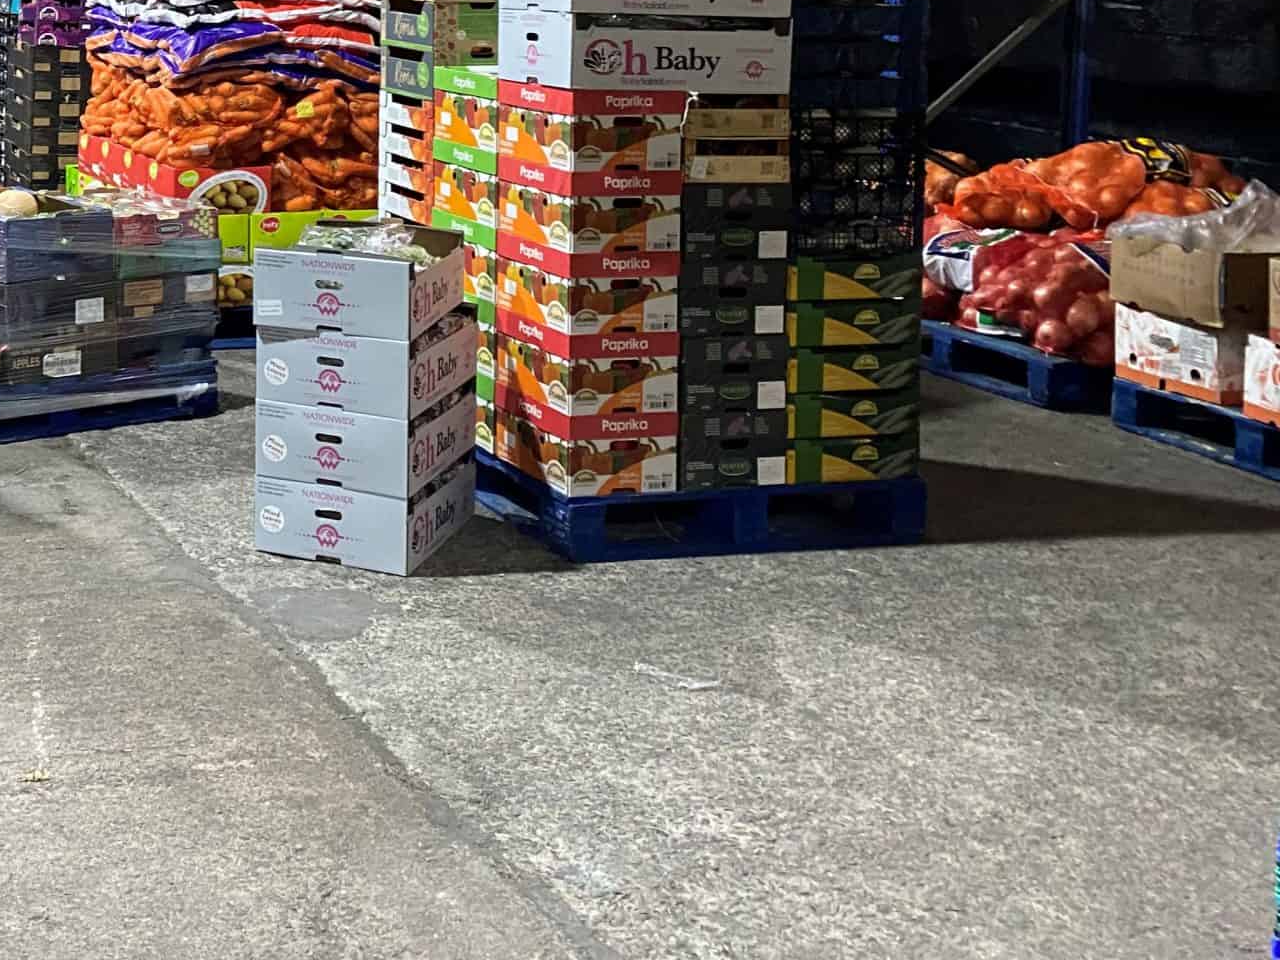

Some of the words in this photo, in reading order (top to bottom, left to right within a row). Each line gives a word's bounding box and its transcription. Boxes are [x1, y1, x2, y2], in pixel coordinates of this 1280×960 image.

[584, 38, 650, 76] Oh
[654, 46, 721, 79] Baby
[453, 76, 476, 90] Paprika
[520, 88, 546, 105] Paprika
[605, 95, 654, 110] Paprika
[453, 147, 474, 163] Paprika
[520, 165, 545, 184] Paprika
[604, 175, 651, 190] Paprika
[519, 243, 544, 262] Paprika
[301, 259, 356, 272] NATIONWIDE
[602, 257, 650, 272] Paprika
[432, 277, 450, 306] Baby
[519, 320, 544, 342] Paprika
[305, 336, 358, 351] NATIONWIDE
[601, 338, 649, 353] Paprika
[437, 352, 459, 382] Baby
[303, 411, 355, 426] NATIONWIDE
[601, 418, 649, 433] Paprika
[436, 427, 457, 456] Baby
[301, 488, 355, 505] NATIONWIDE
[435, 501, 457, 531] Baby
